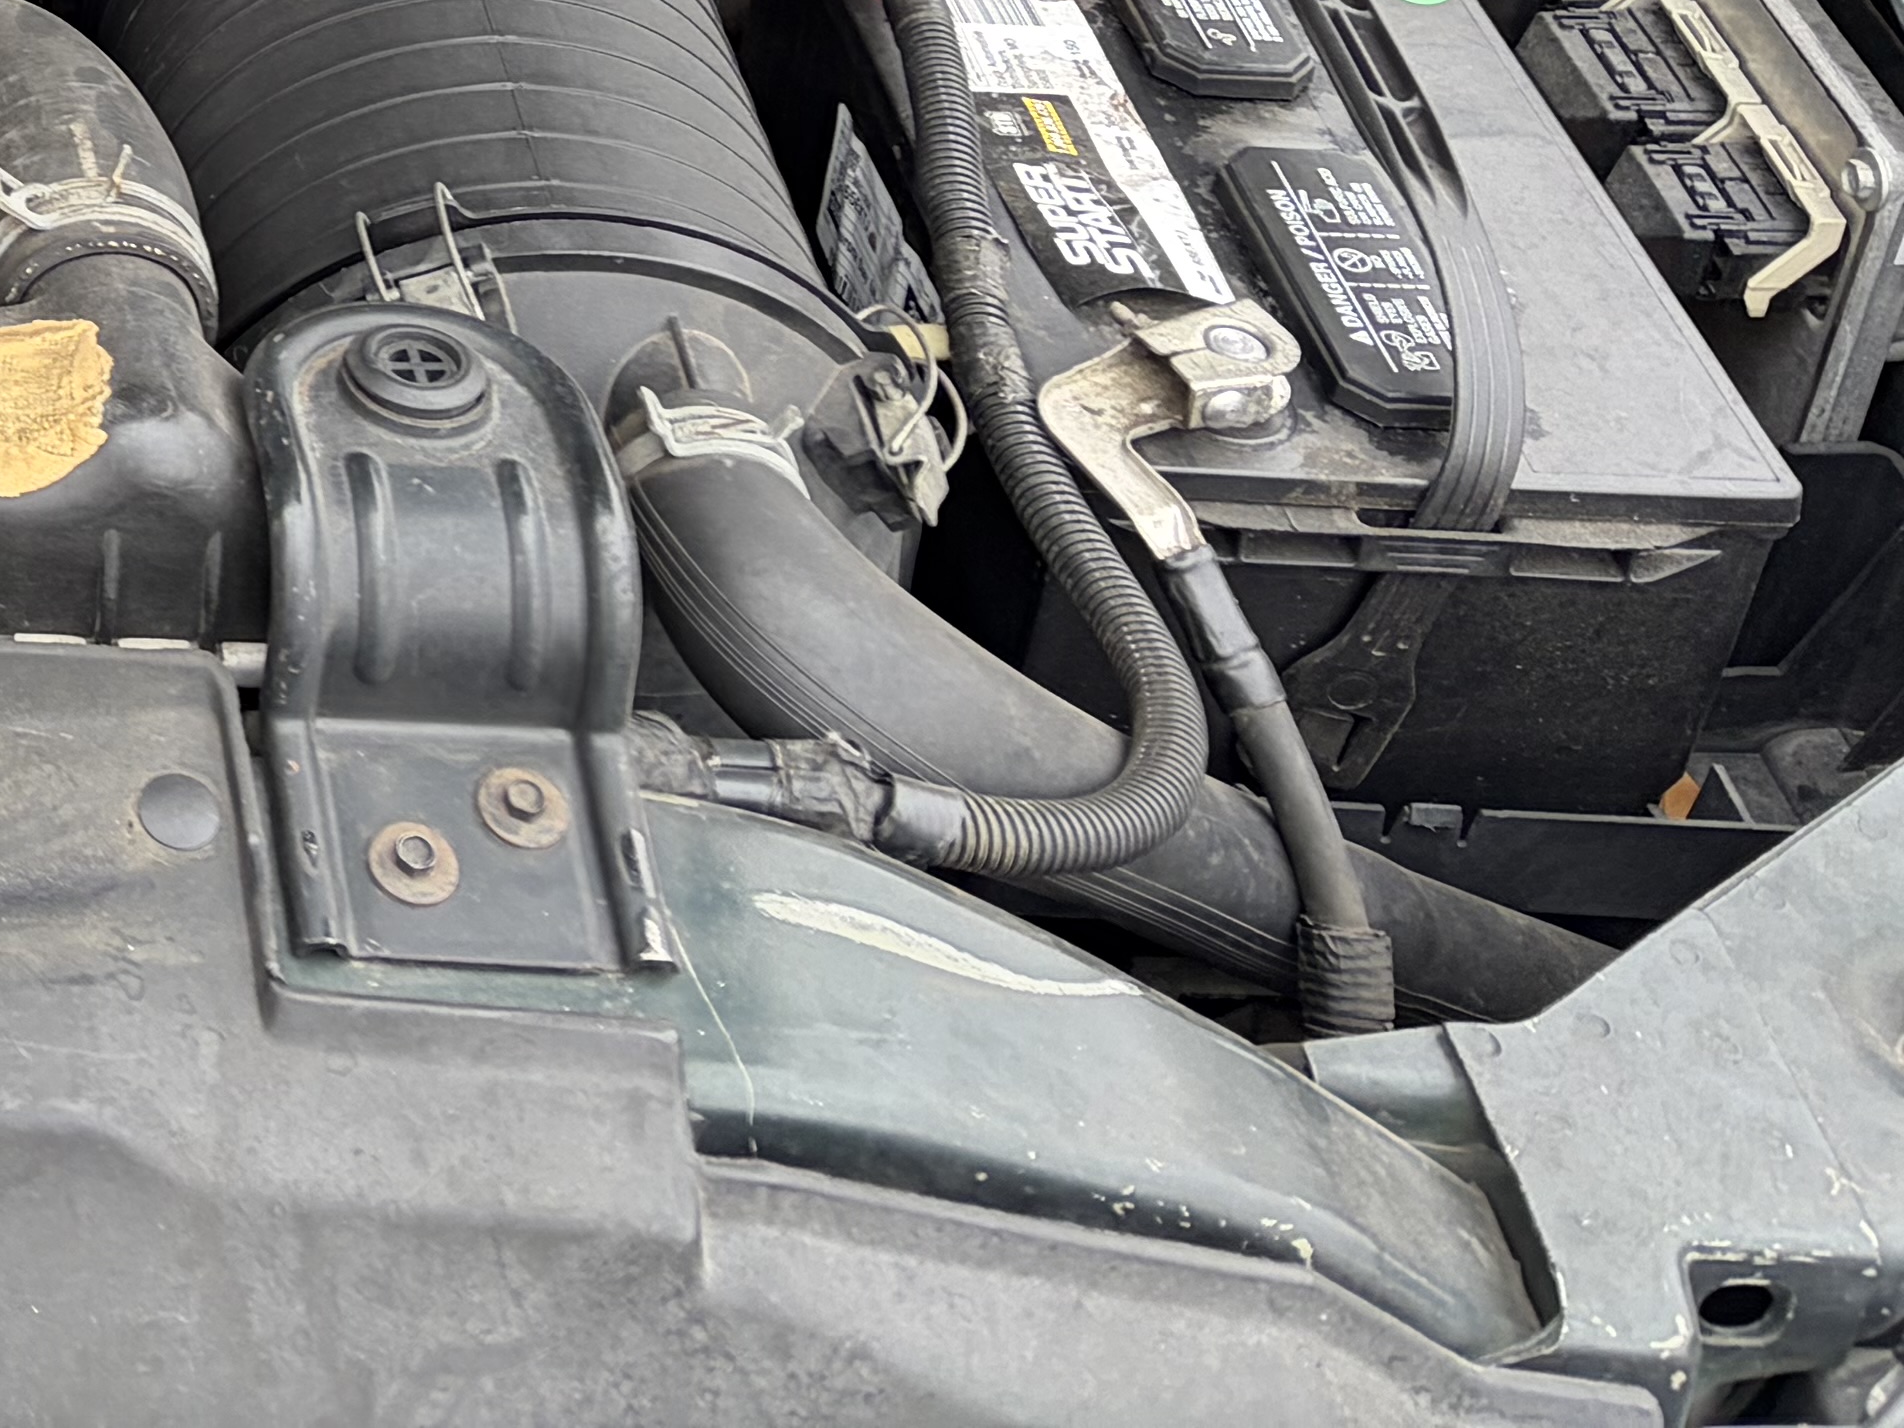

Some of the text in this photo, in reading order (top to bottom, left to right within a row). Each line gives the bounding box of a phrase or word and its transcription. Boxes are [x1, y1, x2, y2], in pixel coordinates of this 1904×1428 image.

[1012, 161, 1092, 266] SUPER
[1265, 188, 1318, 247] POISON
[1309, 261, 1365, 328] DANGER
